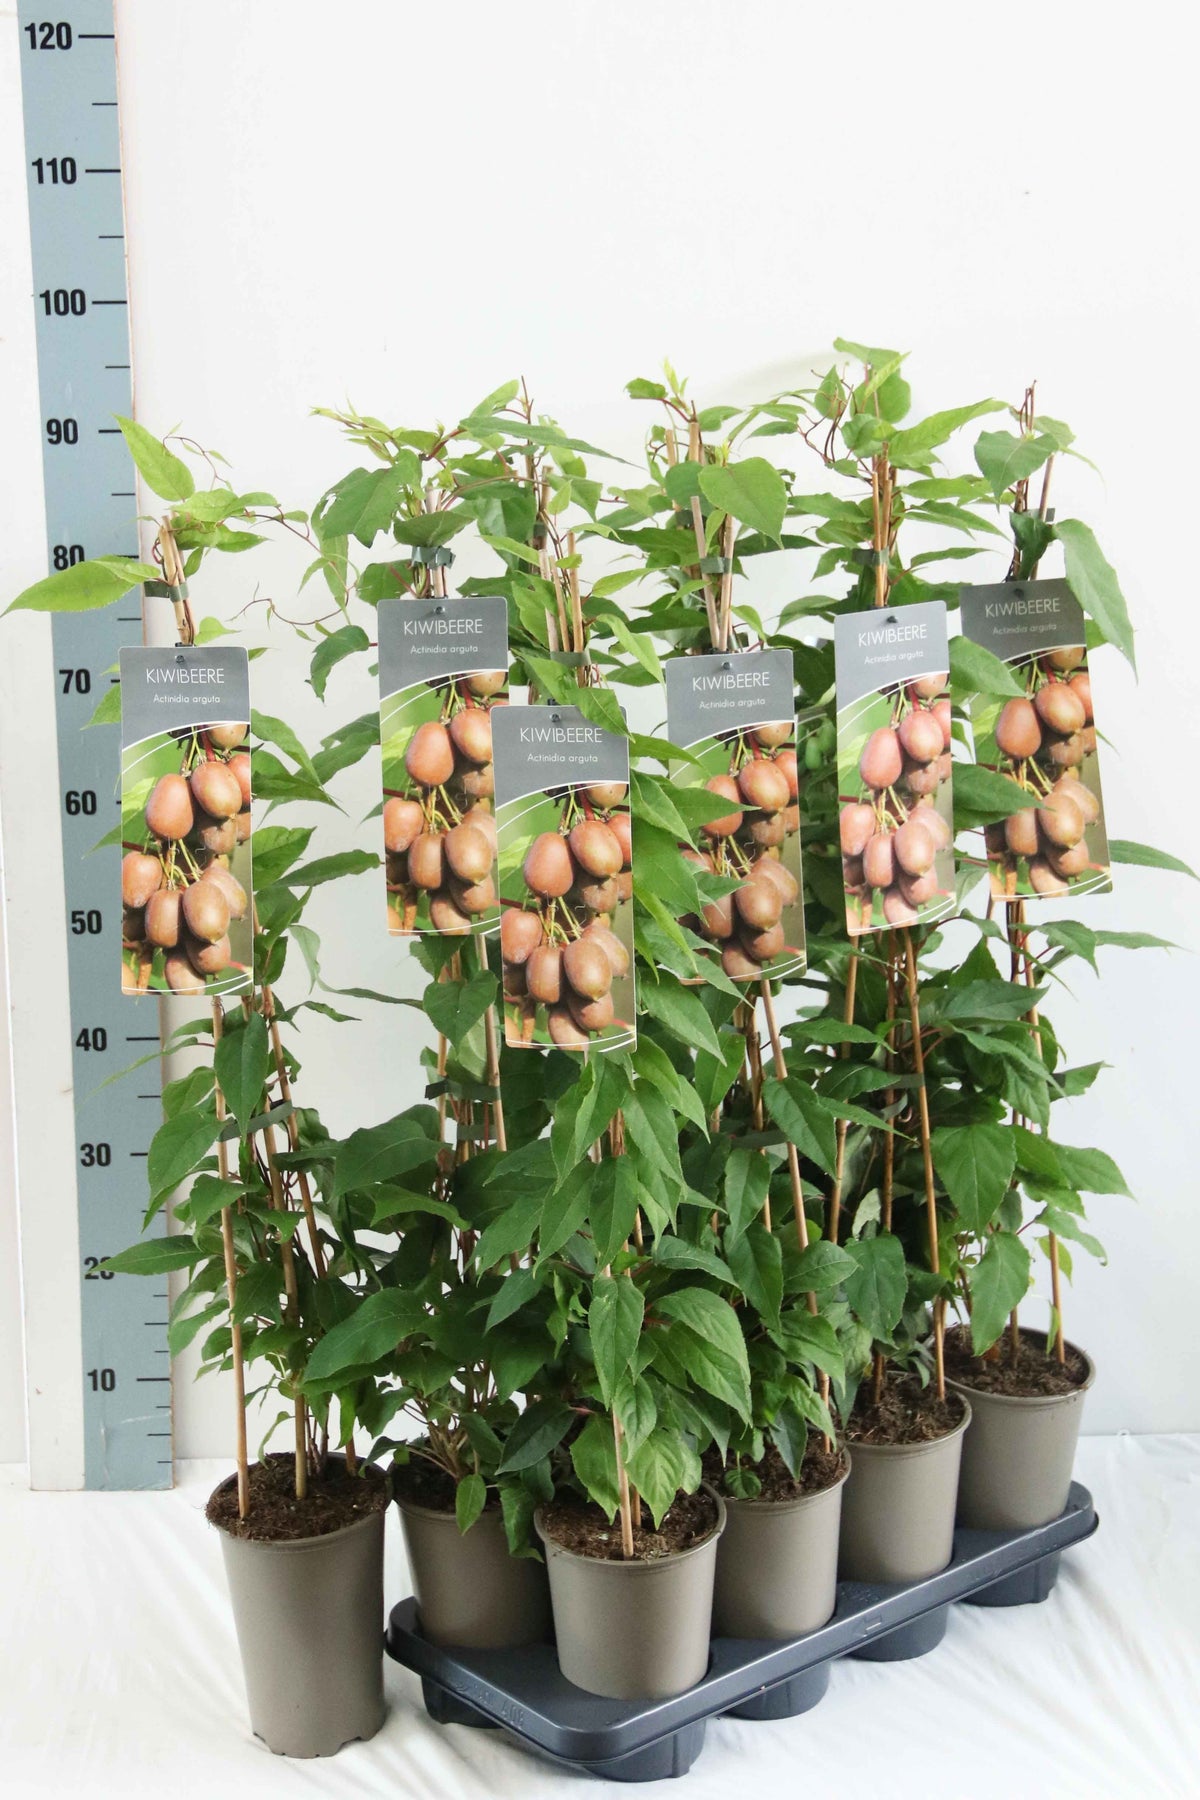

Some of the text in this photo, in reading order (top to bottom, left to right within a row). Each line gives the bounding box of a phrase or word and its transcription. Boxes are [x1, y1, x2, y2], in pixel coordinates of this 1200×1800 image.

[24, 22, 73, 50] 120
[31, 157, 77, 184] 110
[39, 289, 87, 316] 100
[46, 418, 79, 445] 90
[53, 545, 85, 571] 80
[985, 598, 1061, 618] KIWIBEERE
[404, 618, 483, 636] KIWIBEERE
[858, 624, 928, 647] KIWIBEERE
[992, 623, 1058, 636] Actinidia arguta
[410, 644, 478, 655] Actinidia arguta
[864, 649, 924, 665] Actinidia arguta
[59, 669, 91, 694] 70
[146, 668, 225, 684] KIWIBEERE
[692, 671, 770, 691] KIWIBEERE
[153, 694, 221, 705] Actinidia arguta
[699, 697, 765, 710] Actinidia arguta
[520, 727, 603, 743] KIWIBEERE
[527, 753, 598, 764] Actinidia arguta
[65, 790, 97, 816] 60
[71, 910, 102, 935] 50
[76, 1028, 107, 1051] 40
[80, 1143, 112, 1167] 30
[87, 1368, 116, 1391] 10
